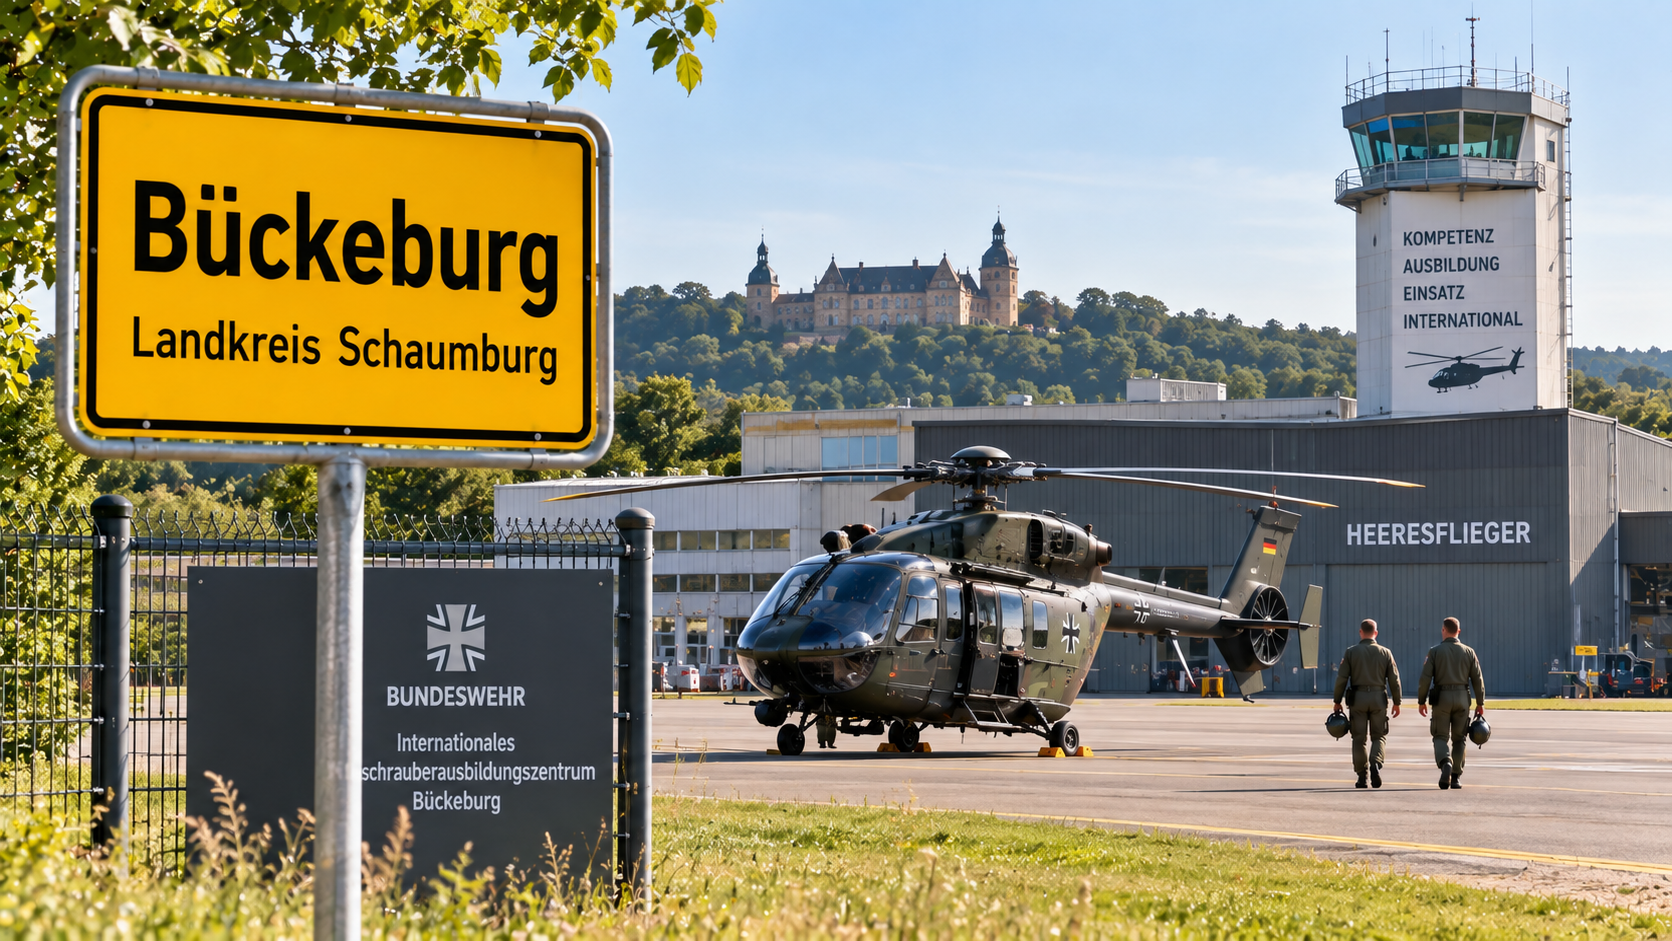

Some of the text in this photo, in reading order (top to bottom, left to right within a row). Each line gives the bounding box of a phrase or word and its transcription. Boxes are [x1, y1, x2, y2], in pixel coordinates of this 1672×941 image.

[1403, 229, 1494, 246] KOMPETENZ
[134, 180, 558, 318] Bückeburg
[1403, 256, 1500, 274] AUSBILDUNG
[1403, 285, 1465, 301] EINSATZ
[1403, 311, 1523, 329] INTERNATIONAL
[133, 316, 557, 385] Landkreis Schaumburg
[1346, 521, 1531, 546] HEERESFLIEGER
[387, 686, 526, 707] BUNDESWEHR
[397, 732, 516, 752] Internationales
[362, 761, 596, 785] schrauberausbildungszentrum
[413, 790, 501, 814] Bückeburg
